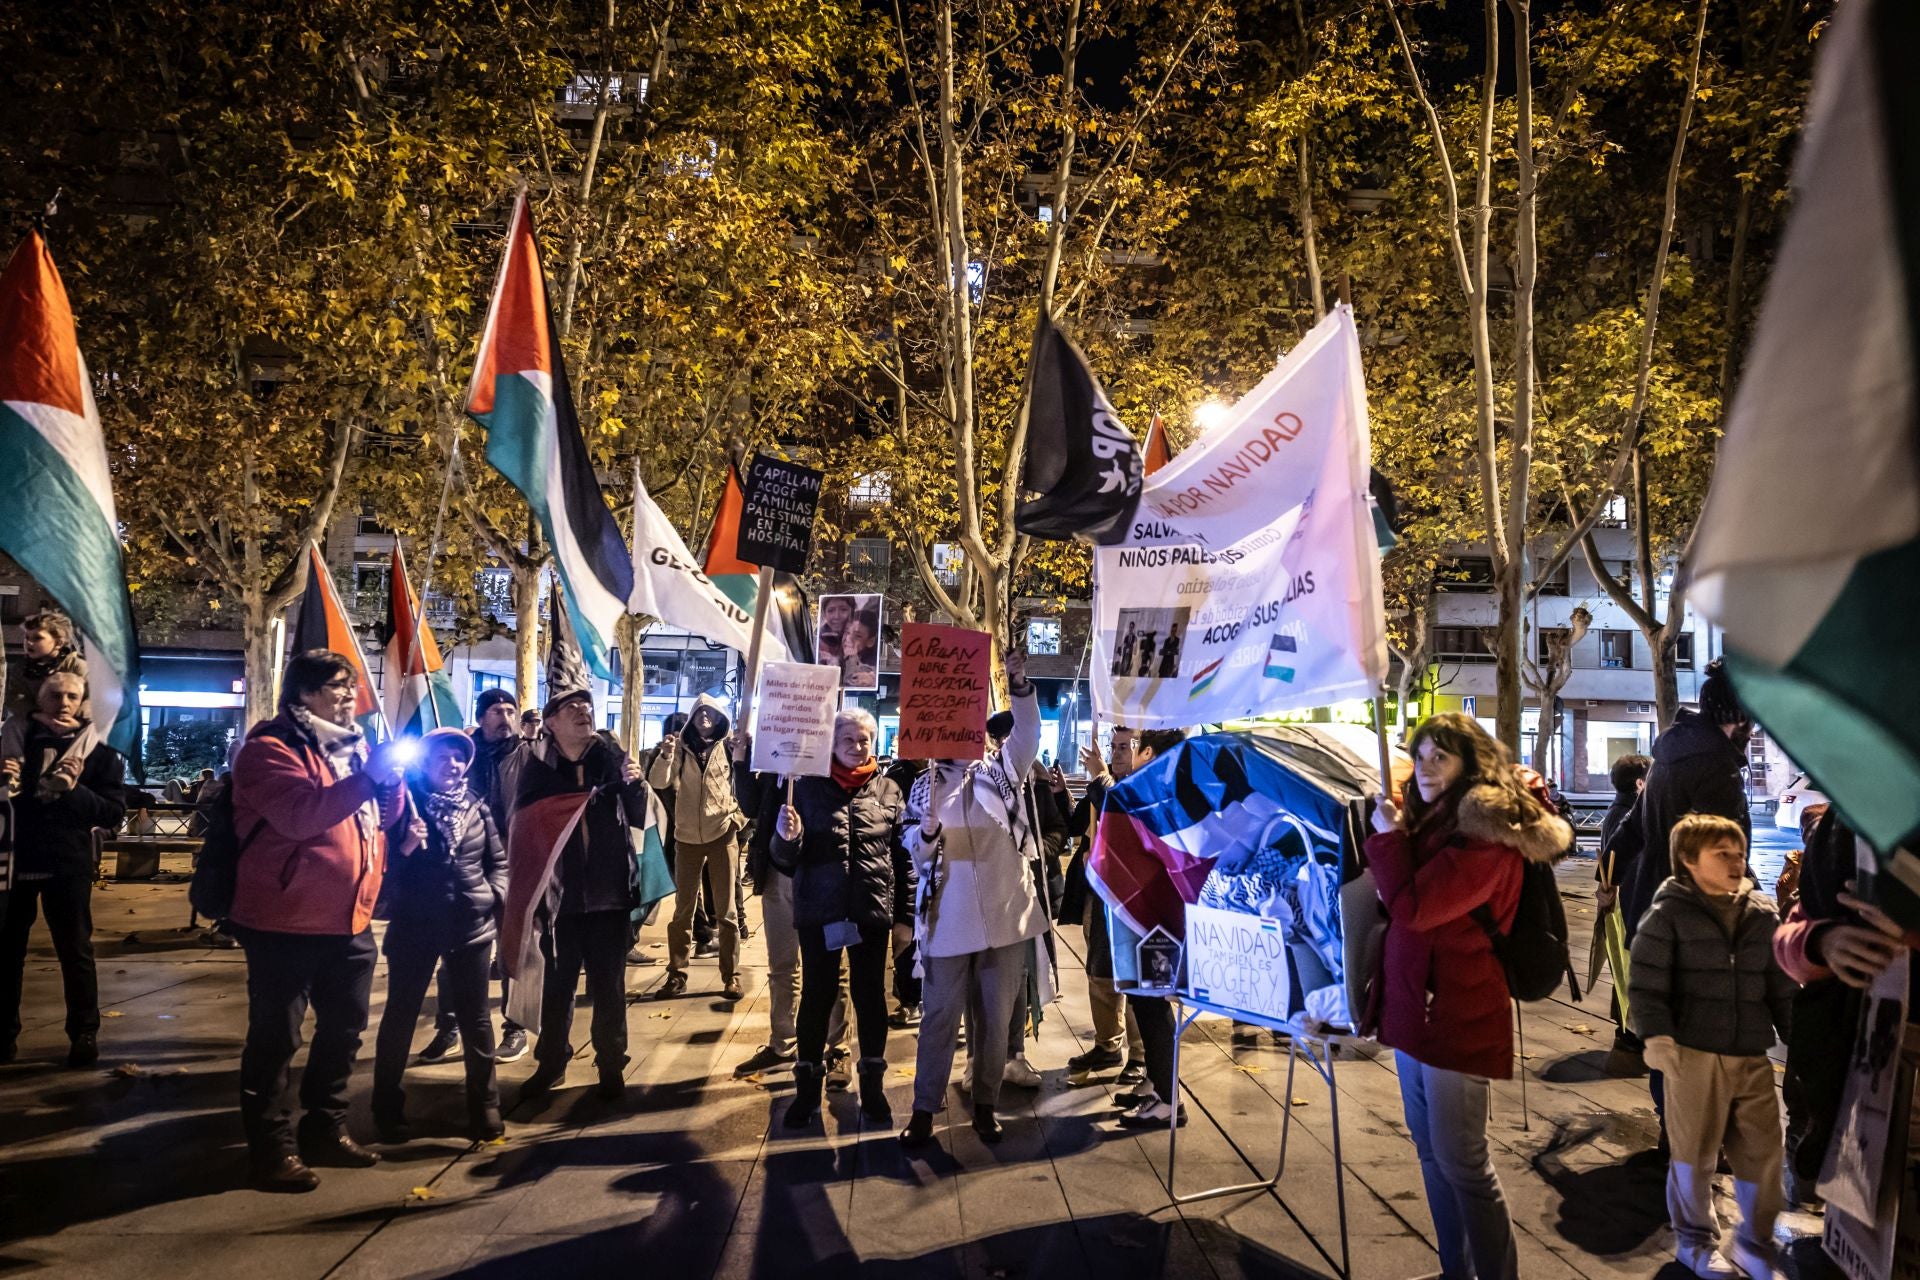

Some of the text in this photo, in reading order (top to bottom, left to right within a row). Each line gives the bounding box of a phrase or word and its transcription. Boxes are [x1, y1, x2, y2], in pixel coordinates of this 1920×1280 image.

[1169, 487, 1213, 514] POR
[1202, 412, 1304, 495] NAVIDAD
[754, 464, 820, 491] CAPELLAN
[758, 480, 798, 499] ACOGE
[753, 492, 812, 515] FAMILIAS
[746, 502, 813, 529] PALESTINAS
[757, 518, 792, 536] EN EL
[1134, 522, 1183, 540] SALVA
[747, 528, 807, 552] HOSPITAL
[1119, 546, 1167, 568] NIÑOS
[1252, 600, 1279, 627] SUS
[905, 637, 979, 660] CAPELLAN
[953, 663, 975, 674] EL
[766, 679, 788, 688] Miles
[790, 680, 800, 689] de
[912, 677, 984, 691] HOSPITAL
[768, 691, 791, 700] niñas
[781, 703, 812, 712] heridos
[773, 724, 794, 735] lugar
[901, 728, 912, 742] A
[1194, 921, 1281, 959] NAVIDAD
[1259, 959, 1272, 971] ES
[1192, 958, 1279, 1000] ACOGER Y
[1233, 991, 1286, 1018] SALVAR
